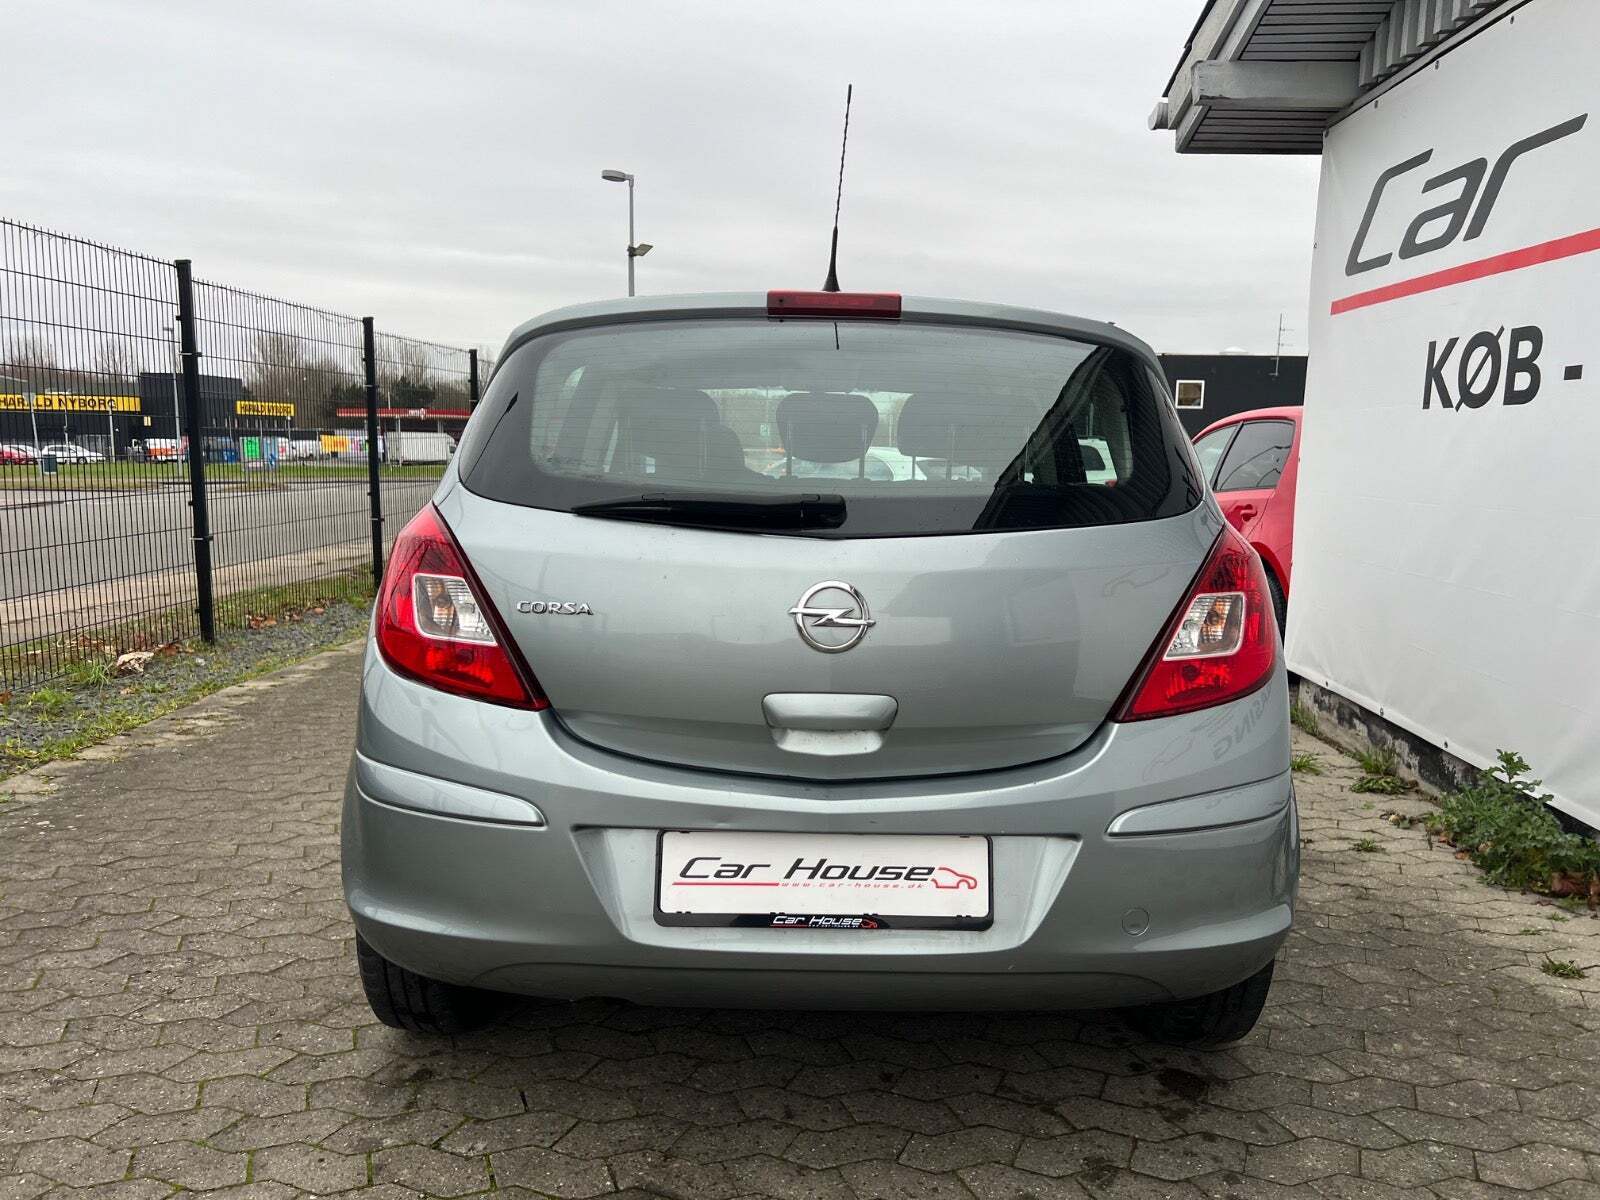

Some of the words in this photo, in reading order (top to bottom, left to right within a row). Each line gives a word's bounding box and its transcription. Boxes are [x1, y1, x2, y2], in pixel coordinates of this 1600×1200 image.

[1345, 113, 1588, 276] Car
[1422, 325, 1543, 411] KØB
[516, 600, 594, 616] CORSA
[679, 856, 771, 879] Car
[784, 858, 936, 882] House
[772, 915, 805, 924] Car
[808, 915, 863, 925] House
